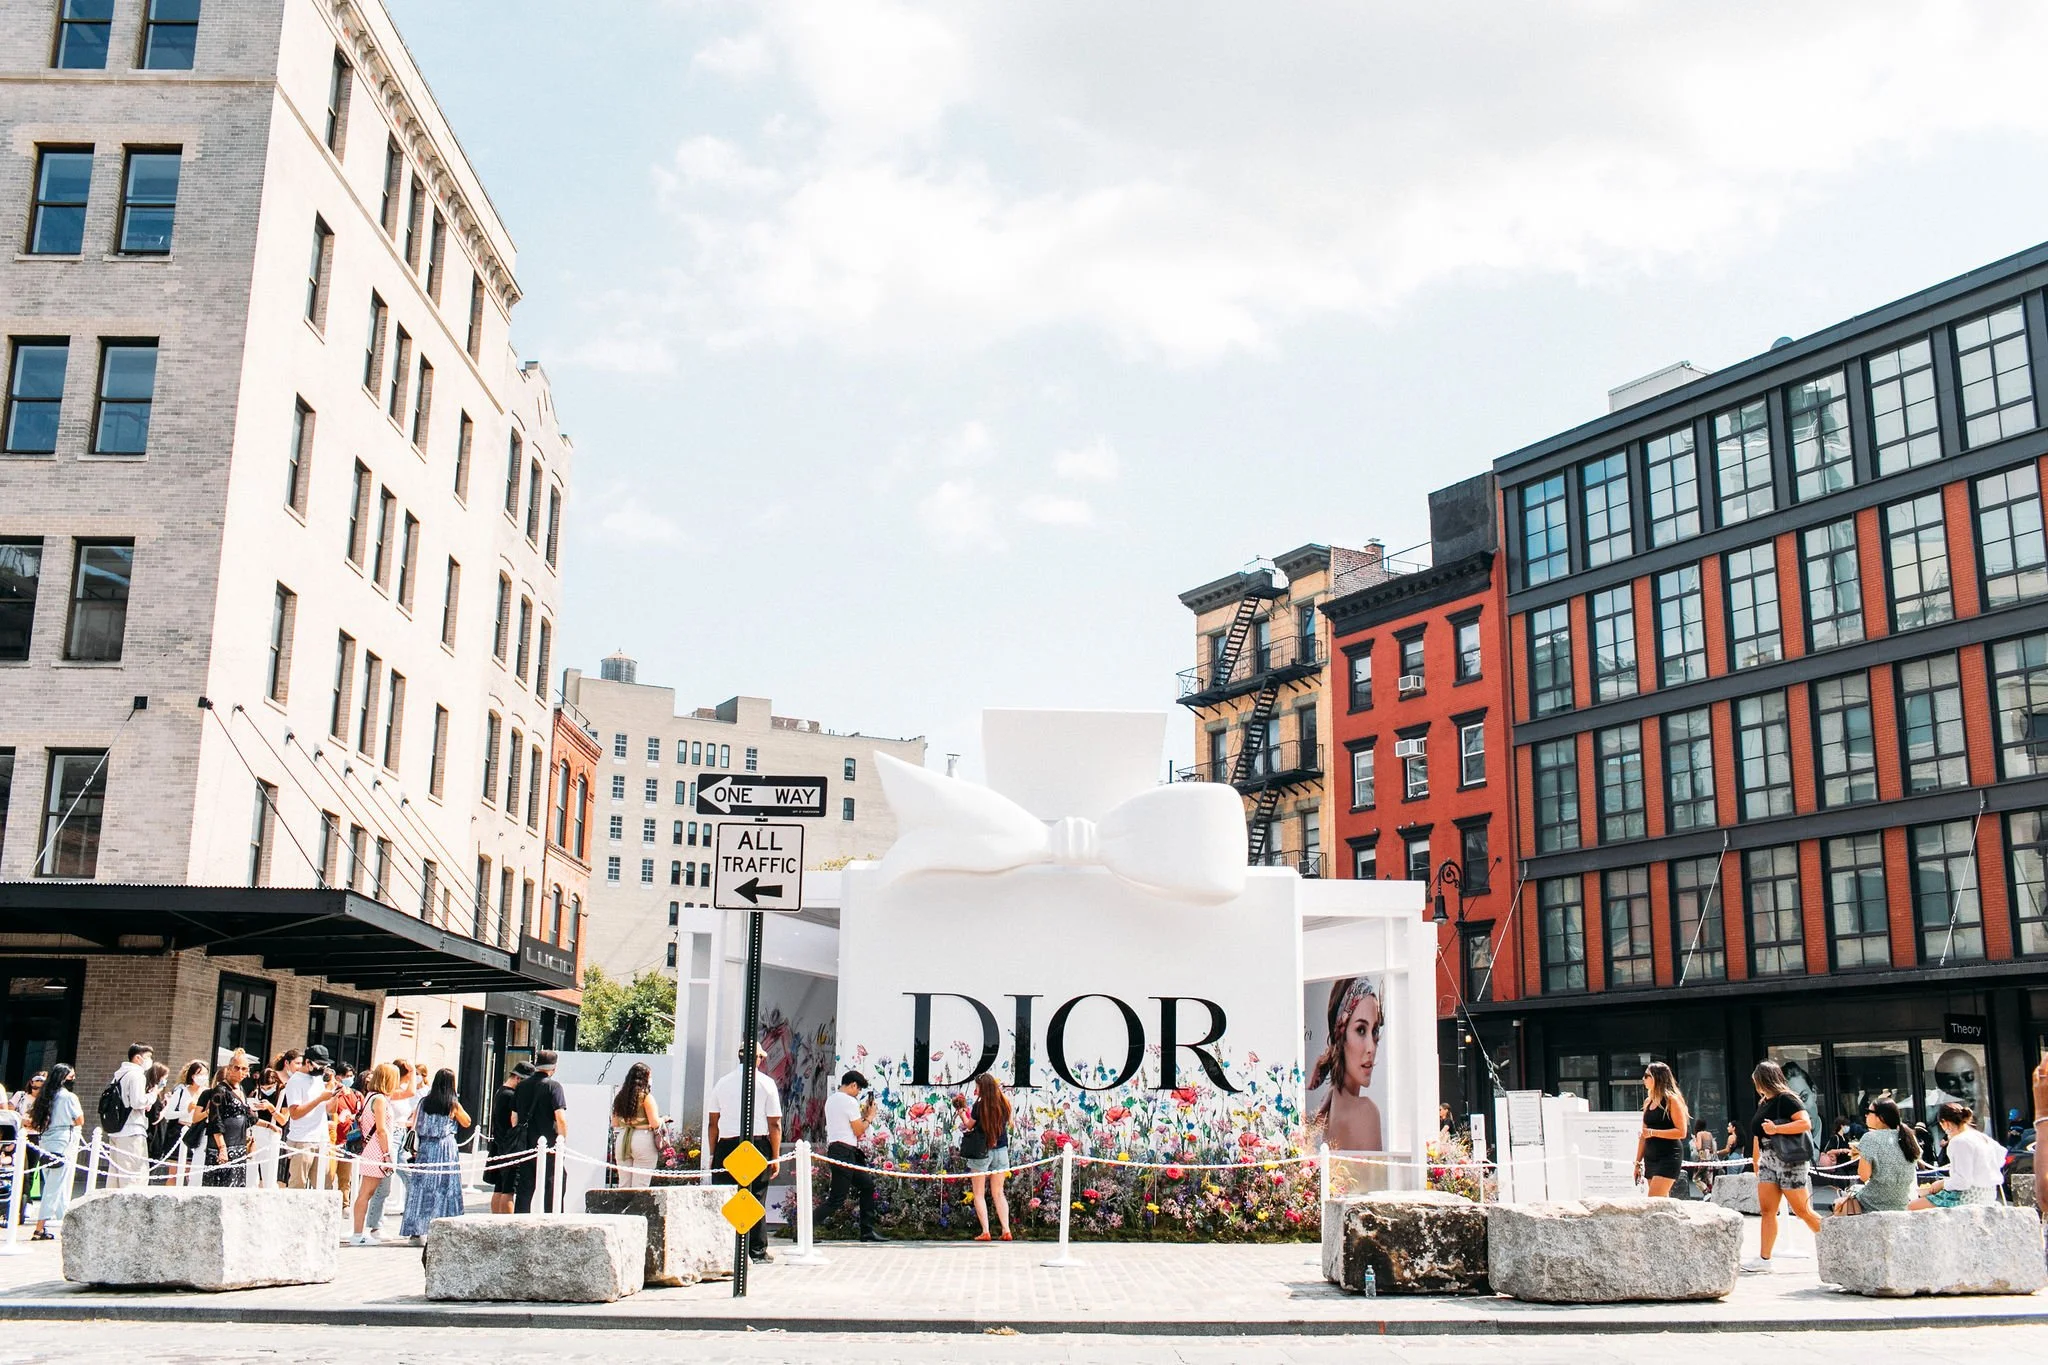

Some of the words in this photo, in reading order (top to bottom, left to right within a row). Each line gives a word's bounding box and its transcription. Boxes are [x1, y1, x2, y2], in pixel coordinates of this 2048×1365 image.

[714, 787, 753, 804] ONE
[775, 788, 817, 805] WAY
[737, 830, 784, 851] ALL
[722, 856, 797, 874] TRAFFIC
[526, 946, 575, 975] LUCID
[1950, 1022, 1982, 1037] Theory
[900, 992, 1243, 1092] DIOR
